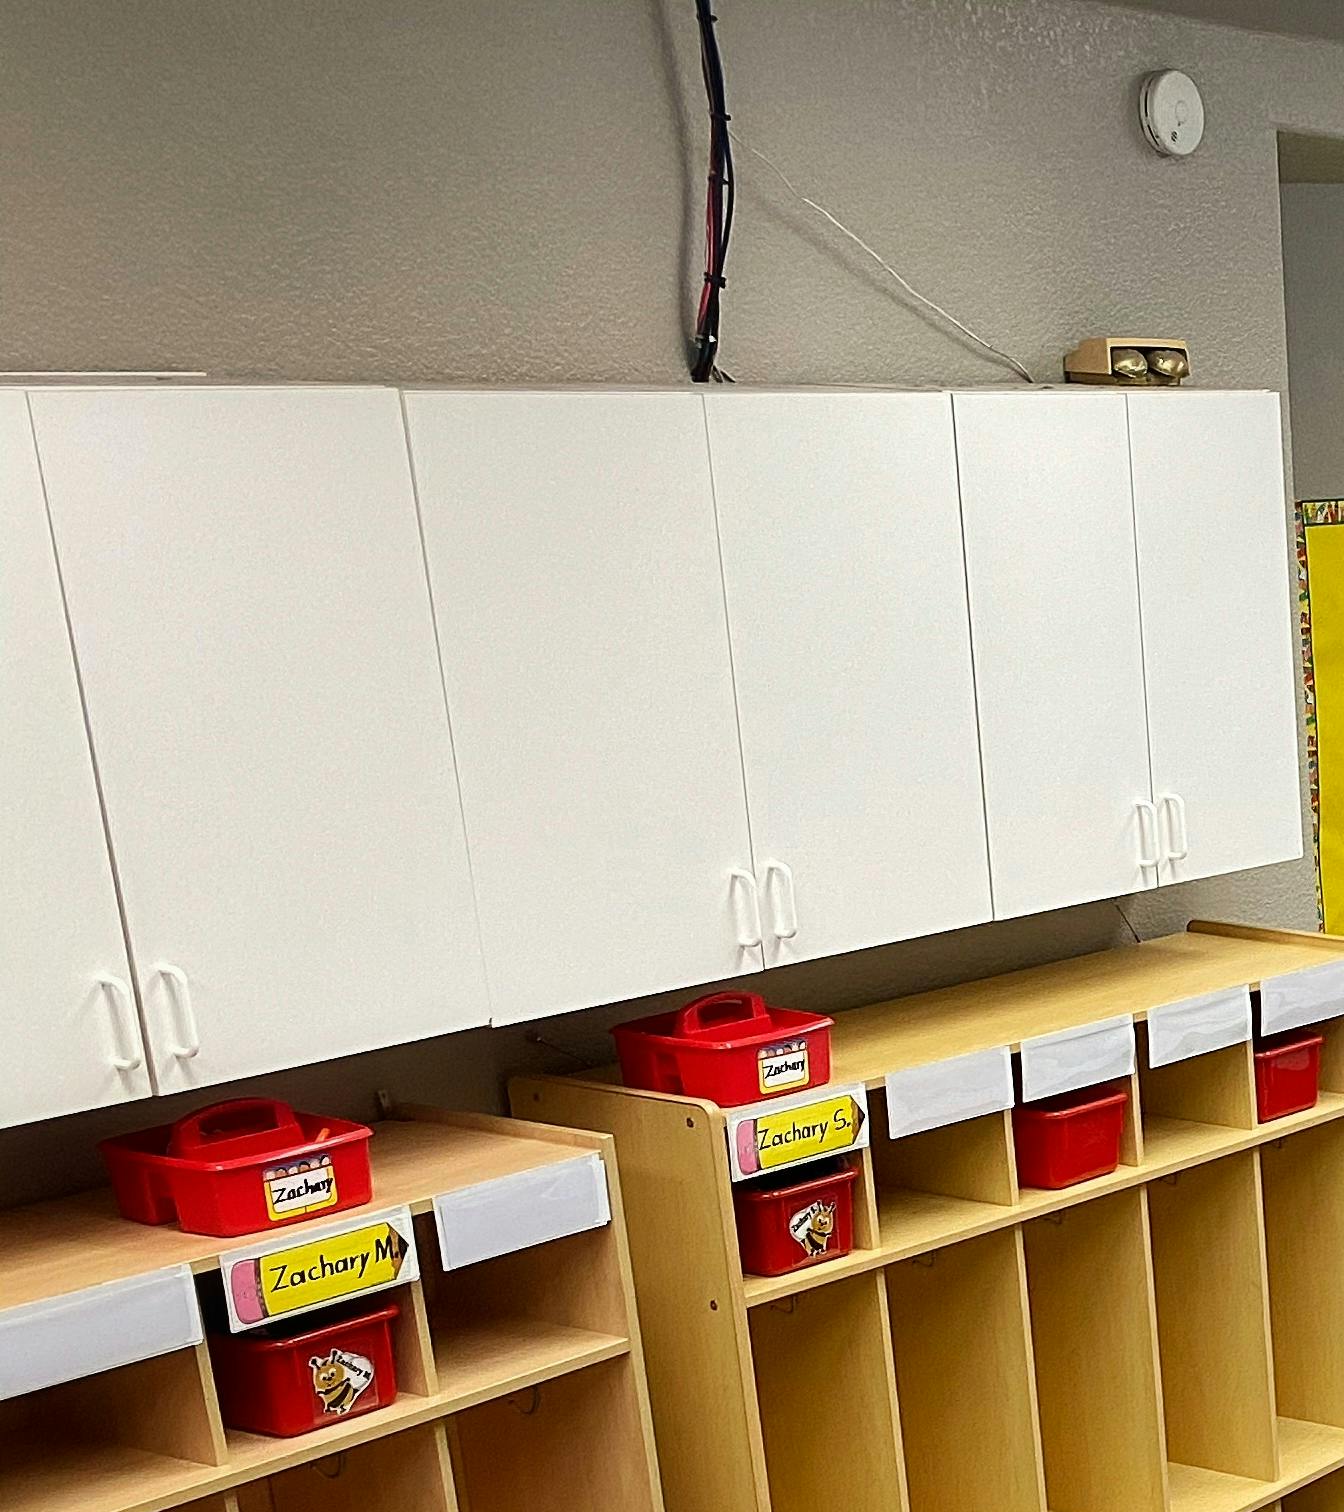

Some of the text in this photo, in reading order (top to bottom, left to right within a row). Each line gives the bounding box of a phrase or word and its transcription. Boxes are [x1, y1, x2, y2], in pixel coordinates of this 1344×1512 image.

[764, 1059, 805, 1079] Zachary
[757, 1108, 851, 1151] Zachary S.
[272, 1178, 333, 1205] Zachary
[269, 1252, 370, 1293] Zachary
